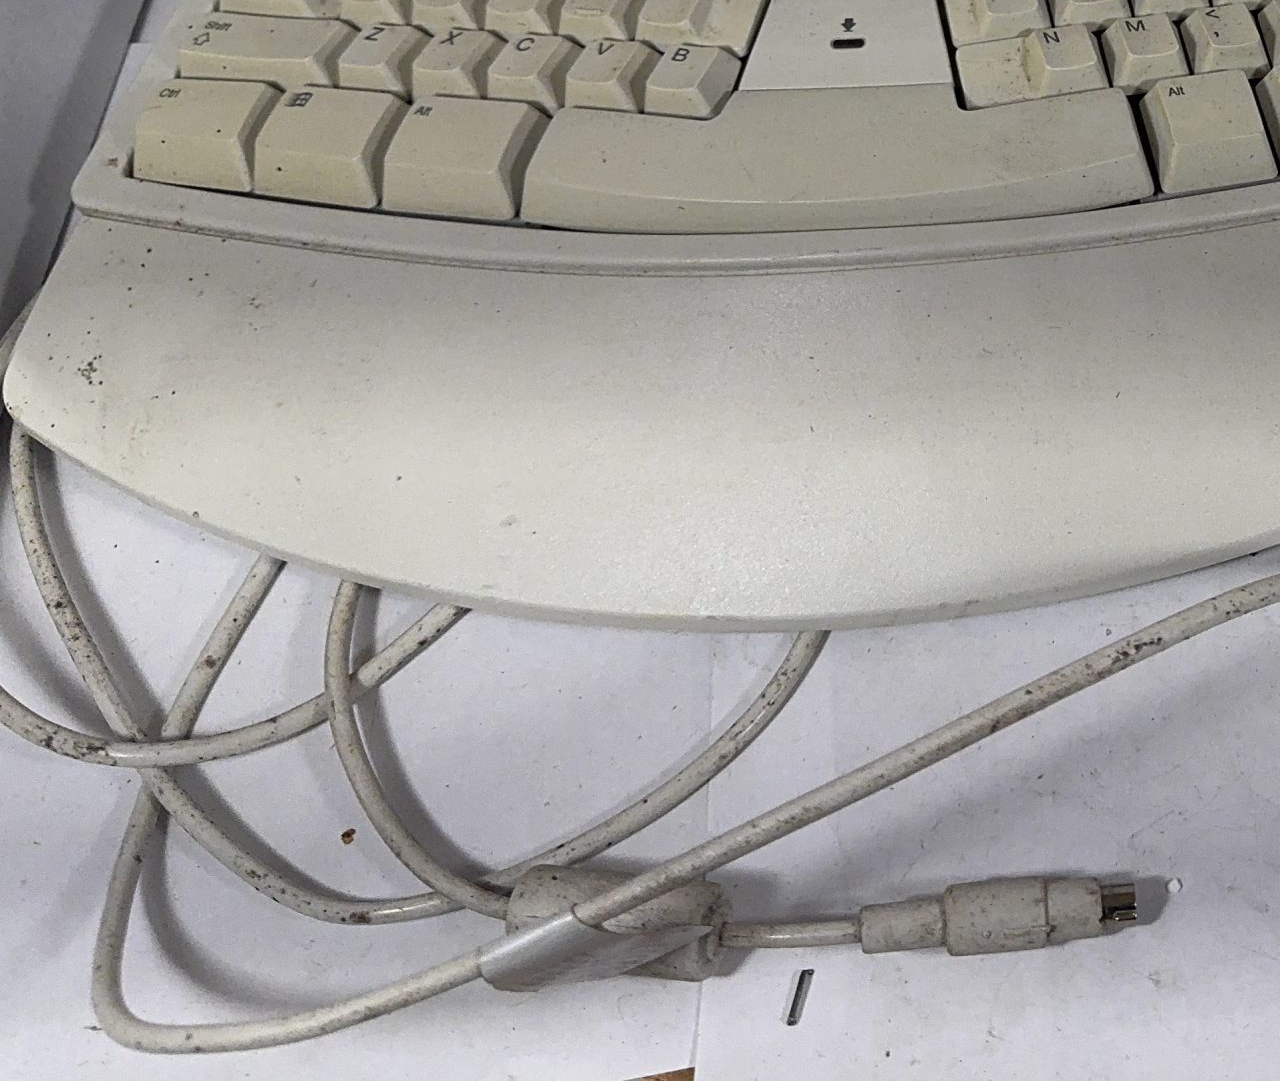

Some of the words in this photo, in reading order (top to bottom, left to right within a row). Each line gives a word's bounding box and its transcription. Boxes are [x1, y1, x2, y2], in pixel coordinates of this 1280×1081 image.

[204, 20, 233, 32] Shift
[1124, 19, 1147, 33] M
[363, 26, 385, 42] Z
[439, 29, 463, 46] X
[1042, 30, 1061, 44] N
[515, 37, 536, 52] C
[598, 41, 616, 57] V
[670, 47, 691, 63] B
[158, 87, 182, 100] Ctrl
[1167, 86, 1186, 97] Alt
[413, 105, 434, 117] Alt
